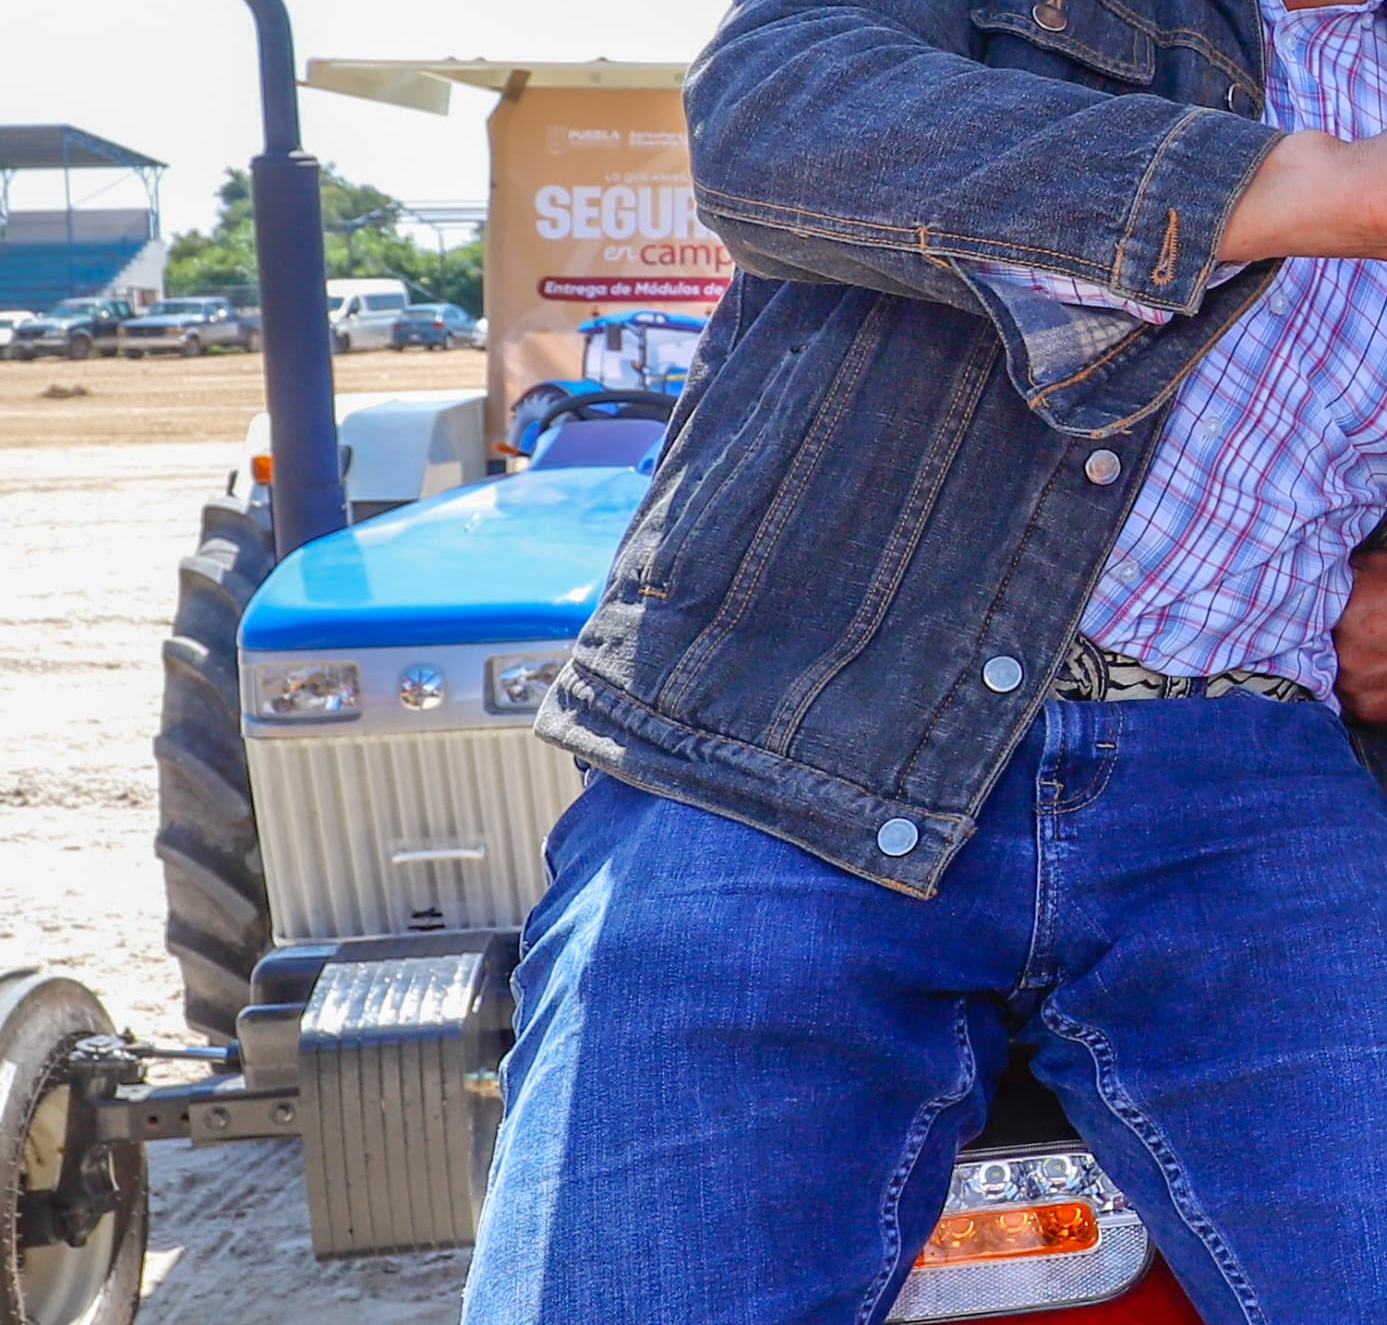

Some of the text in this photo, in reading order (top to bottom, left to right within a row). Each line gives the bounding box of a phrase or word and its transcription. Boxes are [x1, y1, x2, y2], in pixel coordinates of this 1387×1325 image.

[603, 242, 734, 273] en camp
[544, 279, 724, 299] Entrega de Módulos de
